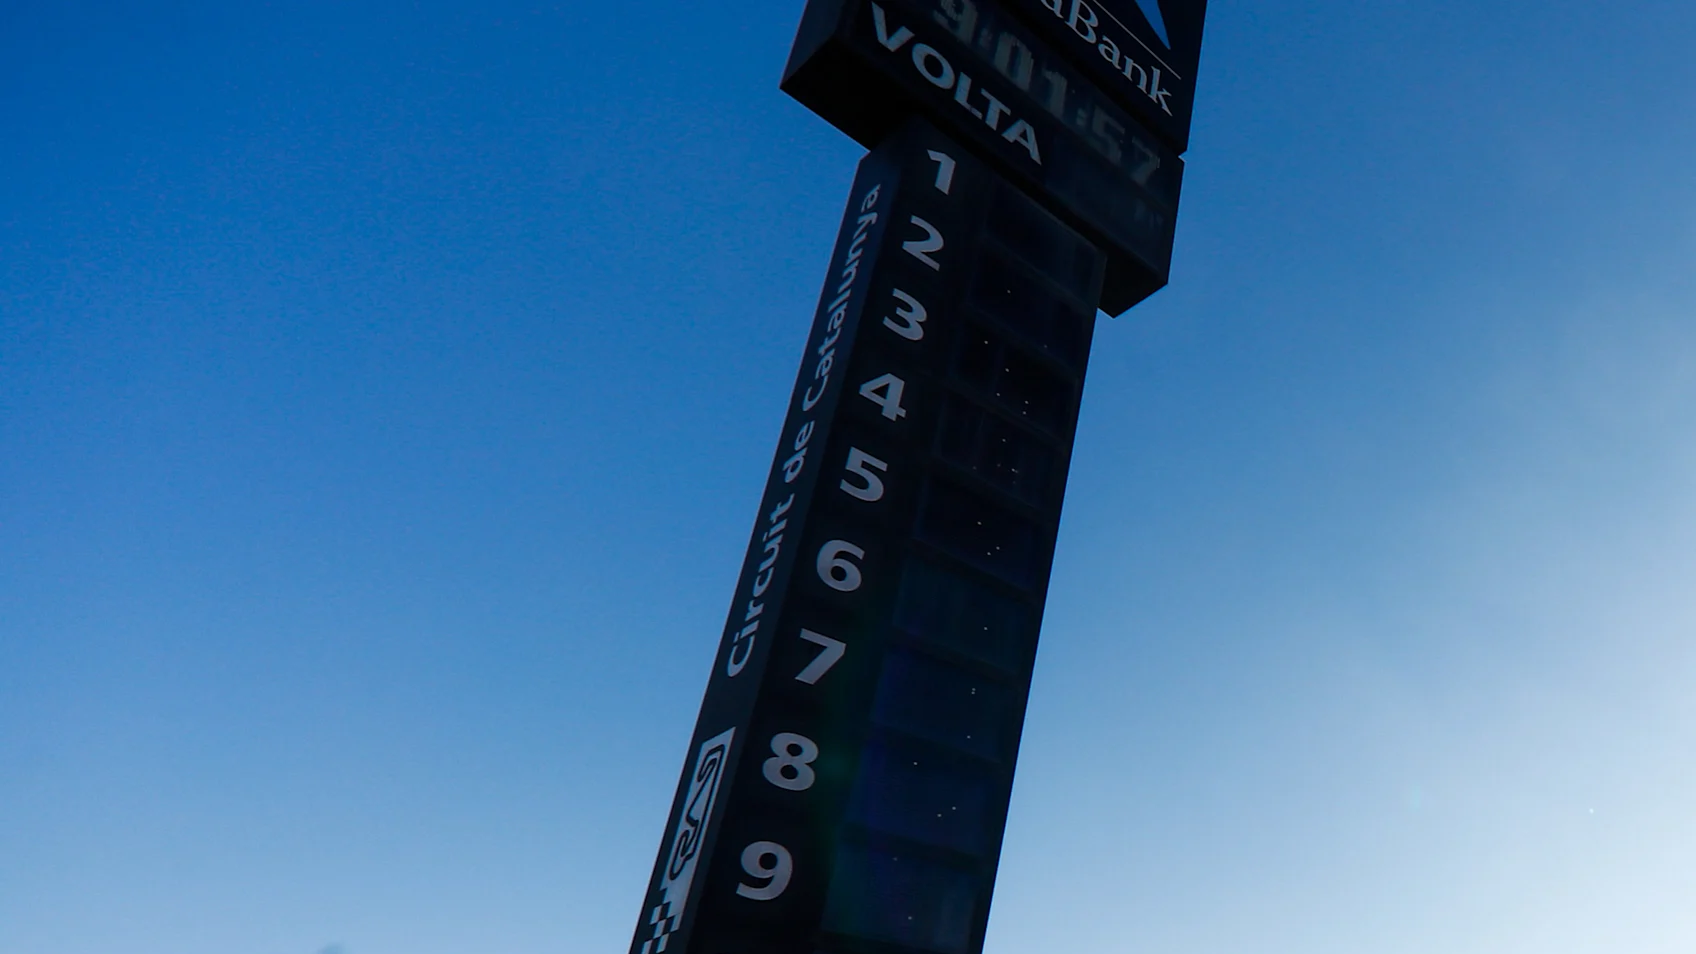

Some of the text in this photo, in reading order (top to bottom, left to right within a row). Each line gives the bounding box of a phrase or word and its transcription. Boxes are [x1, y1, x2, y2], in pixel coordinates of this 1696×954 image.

[870, 1, 1042, 166] VOLTA
[926, 149, 956, 195] 1
[902, 215, 944, 271] 2
[883, 288, 927, 341] 3
[859, 373, 907, 421] 4
[727, 183, 881, 678] Circuit de Catalunya
[840, 446, 888, 502] 5
[817, 539, 865, 592] 6
[795, 628, 847, 685] 7
[763, 732, 819, 791] 8
[736, 841, 793, 901] 9
